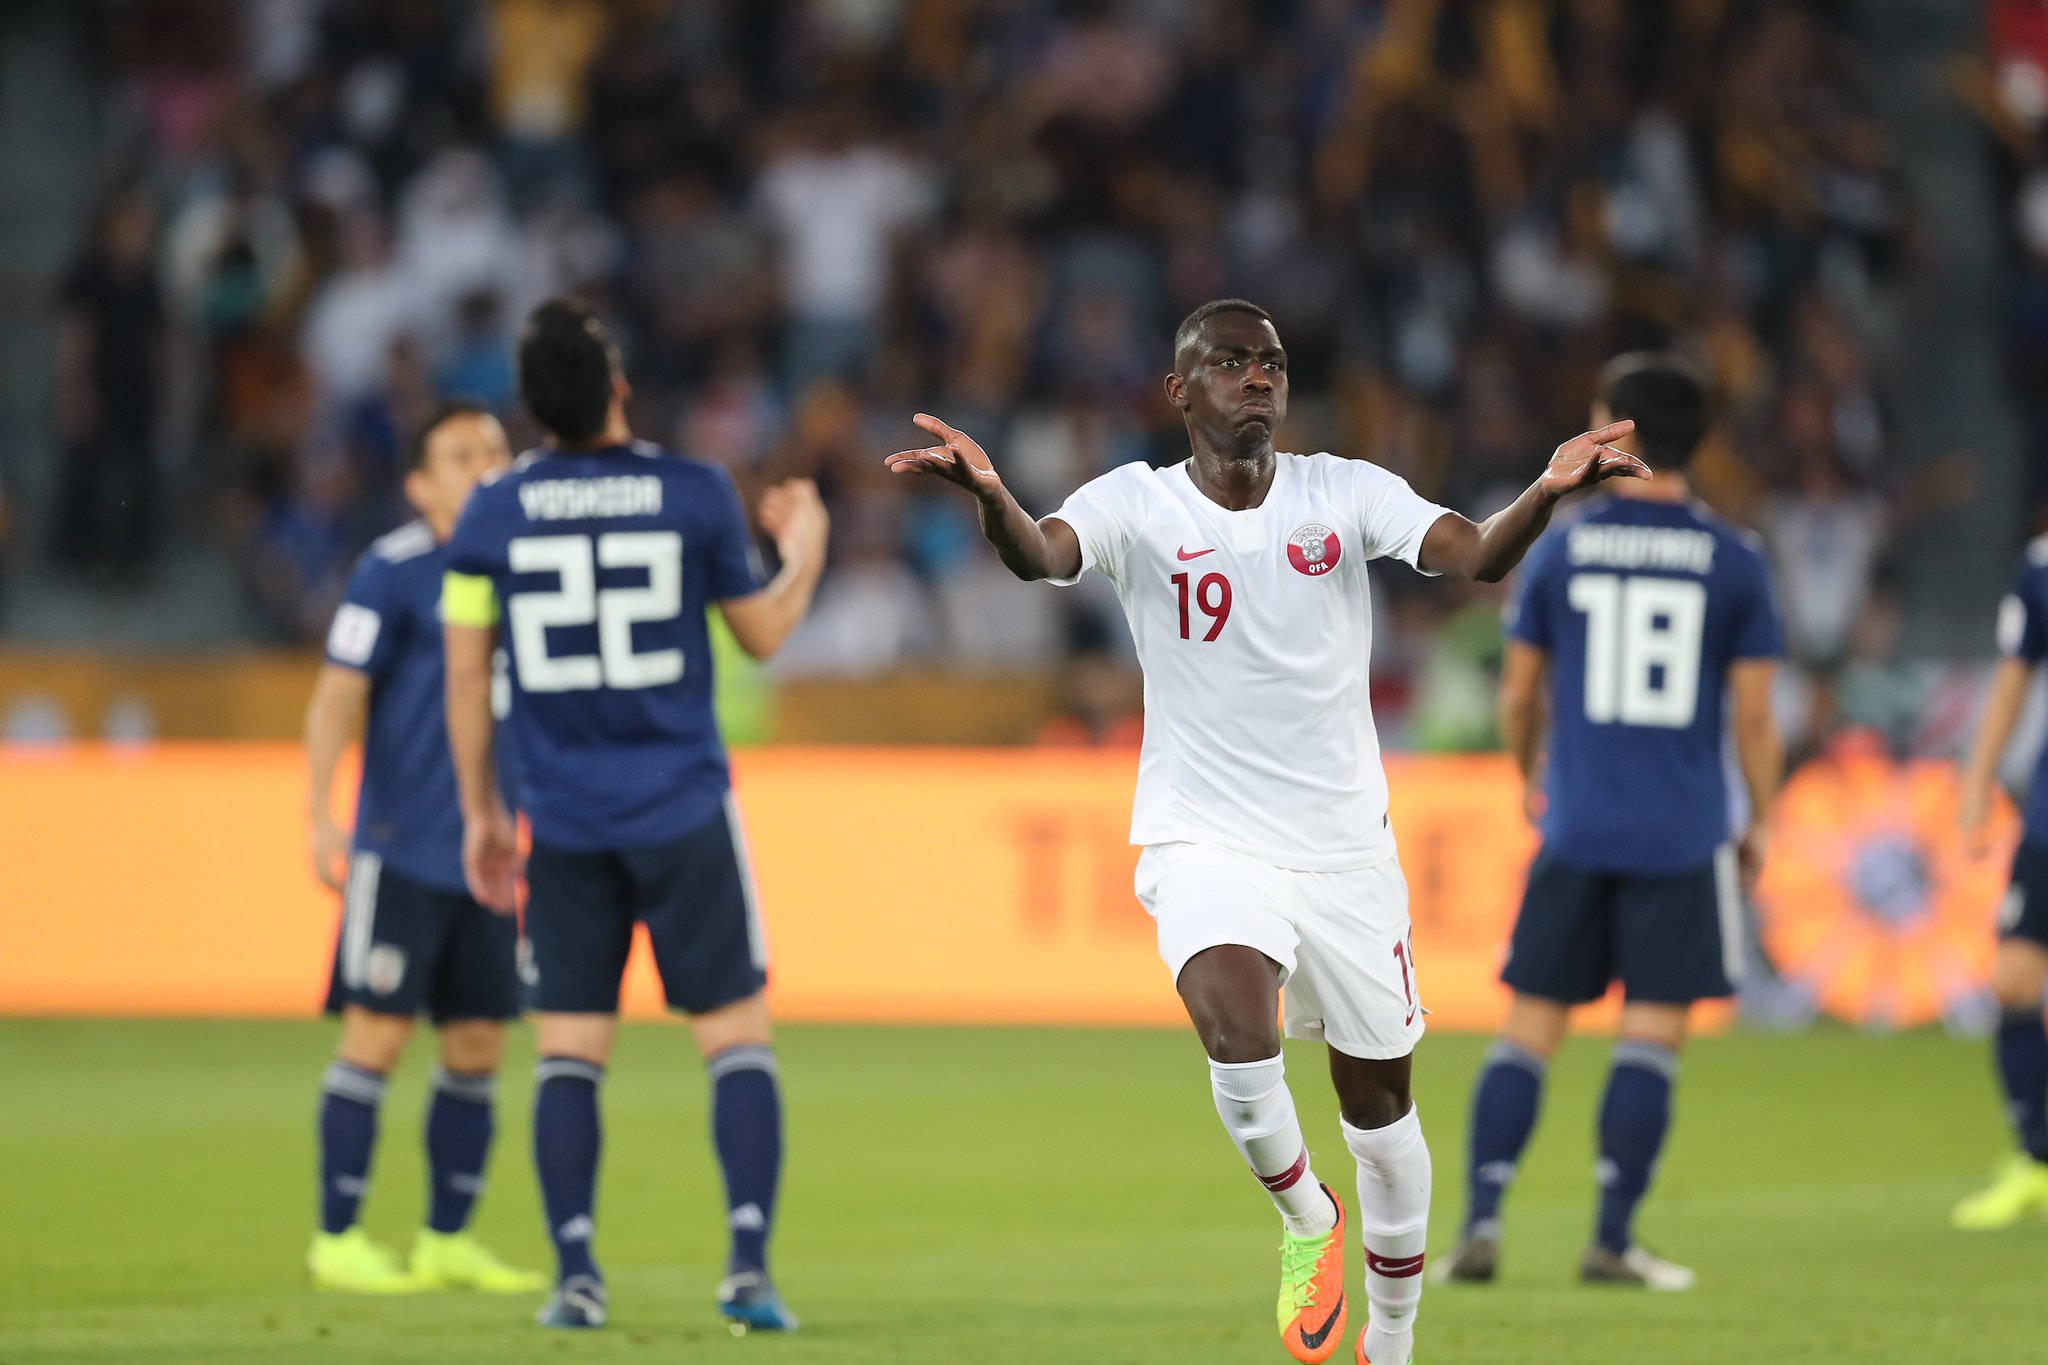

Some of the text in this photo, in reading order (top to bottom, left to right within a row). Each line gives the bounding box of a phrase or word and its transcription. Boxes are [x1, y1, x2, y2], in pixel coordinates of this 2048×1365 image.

[508, 531, 684, 692] 22
[1171, 572, 1232, 642] 19
[1308, 562, 1329, 573] QFA
[1568, 573, 1706, 728] 18
[1393, 925, 1416, 1027] 1
